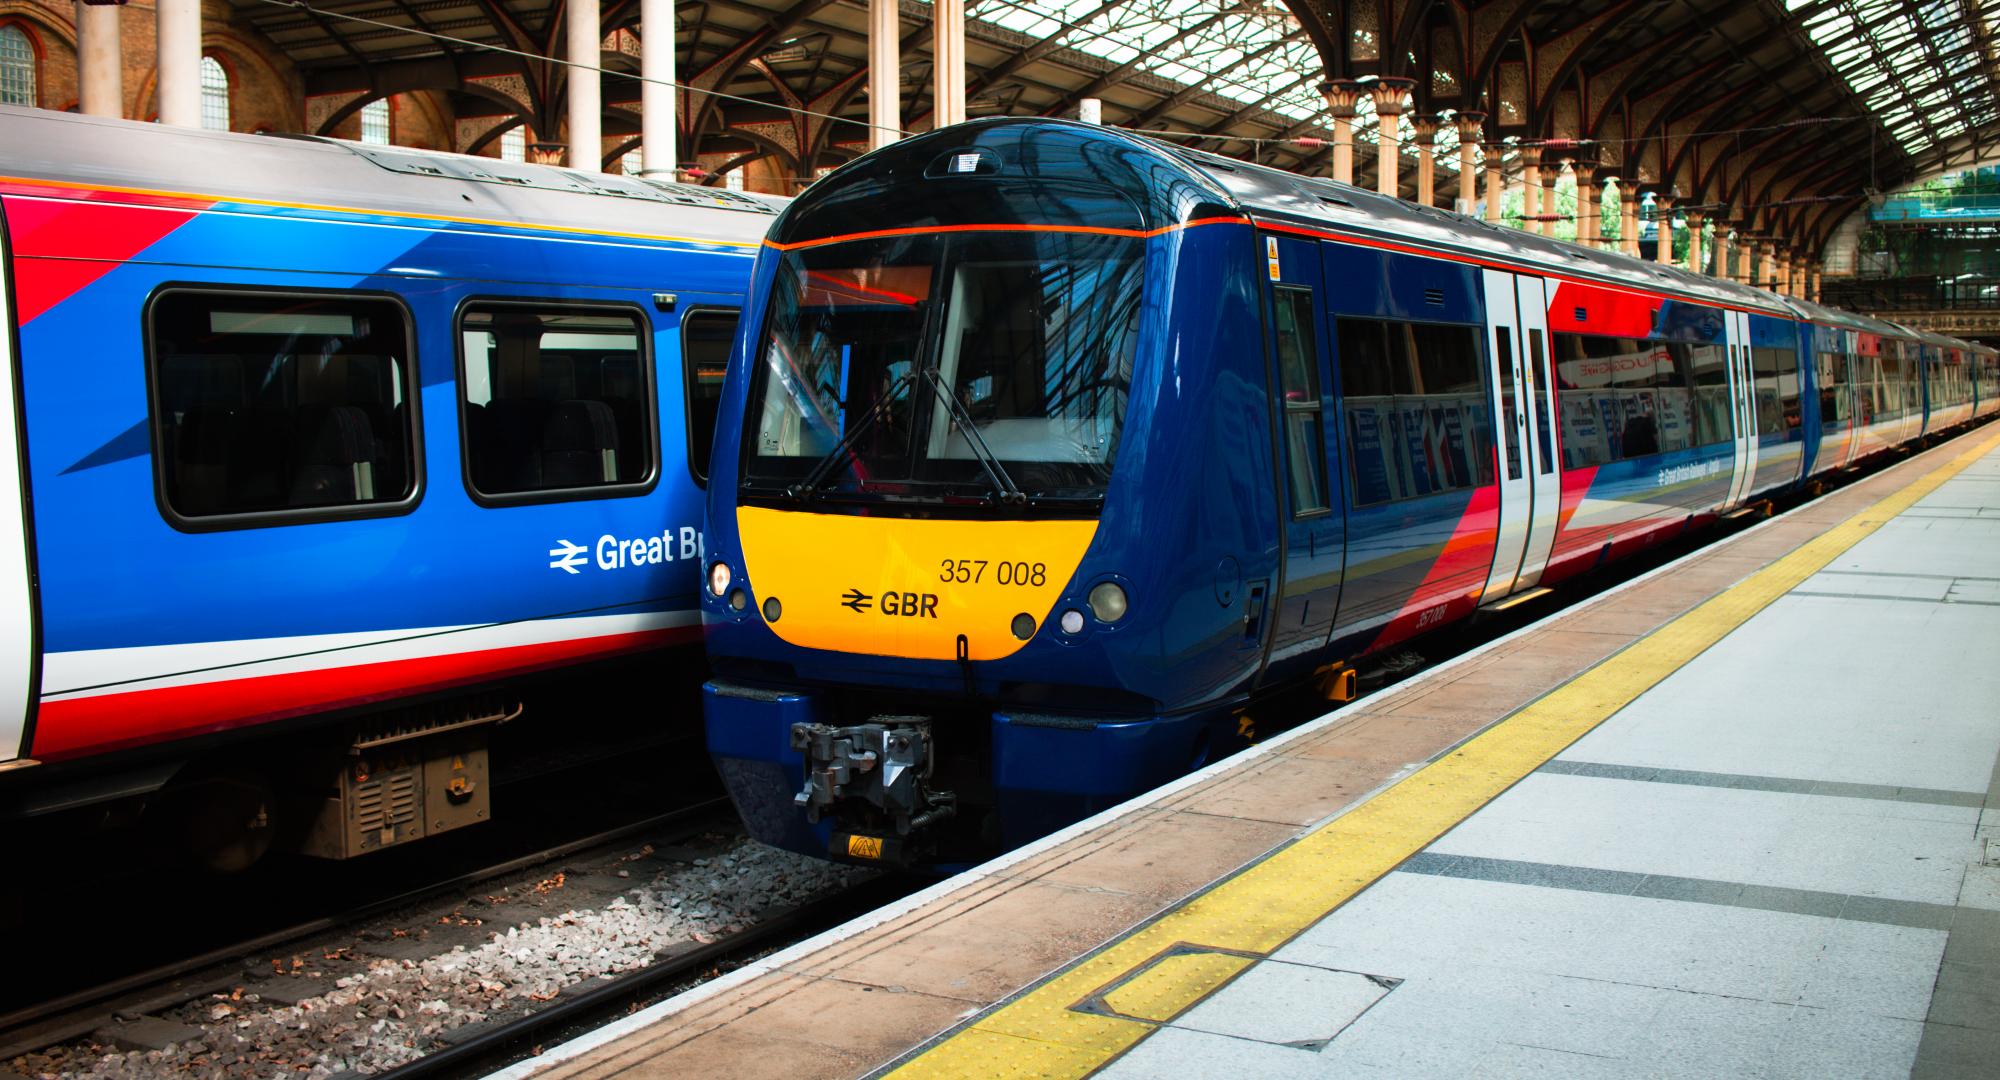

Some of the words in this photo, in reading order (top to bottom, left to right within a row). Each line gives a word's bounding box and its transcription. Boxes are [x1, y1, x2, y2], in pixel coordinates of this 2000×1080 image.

[596, 529, 674, 571] Great
[939, 558, 989, 584] 357
[997, 561, 1047, 587] 008
[880, 590, 939, 619] GBR
